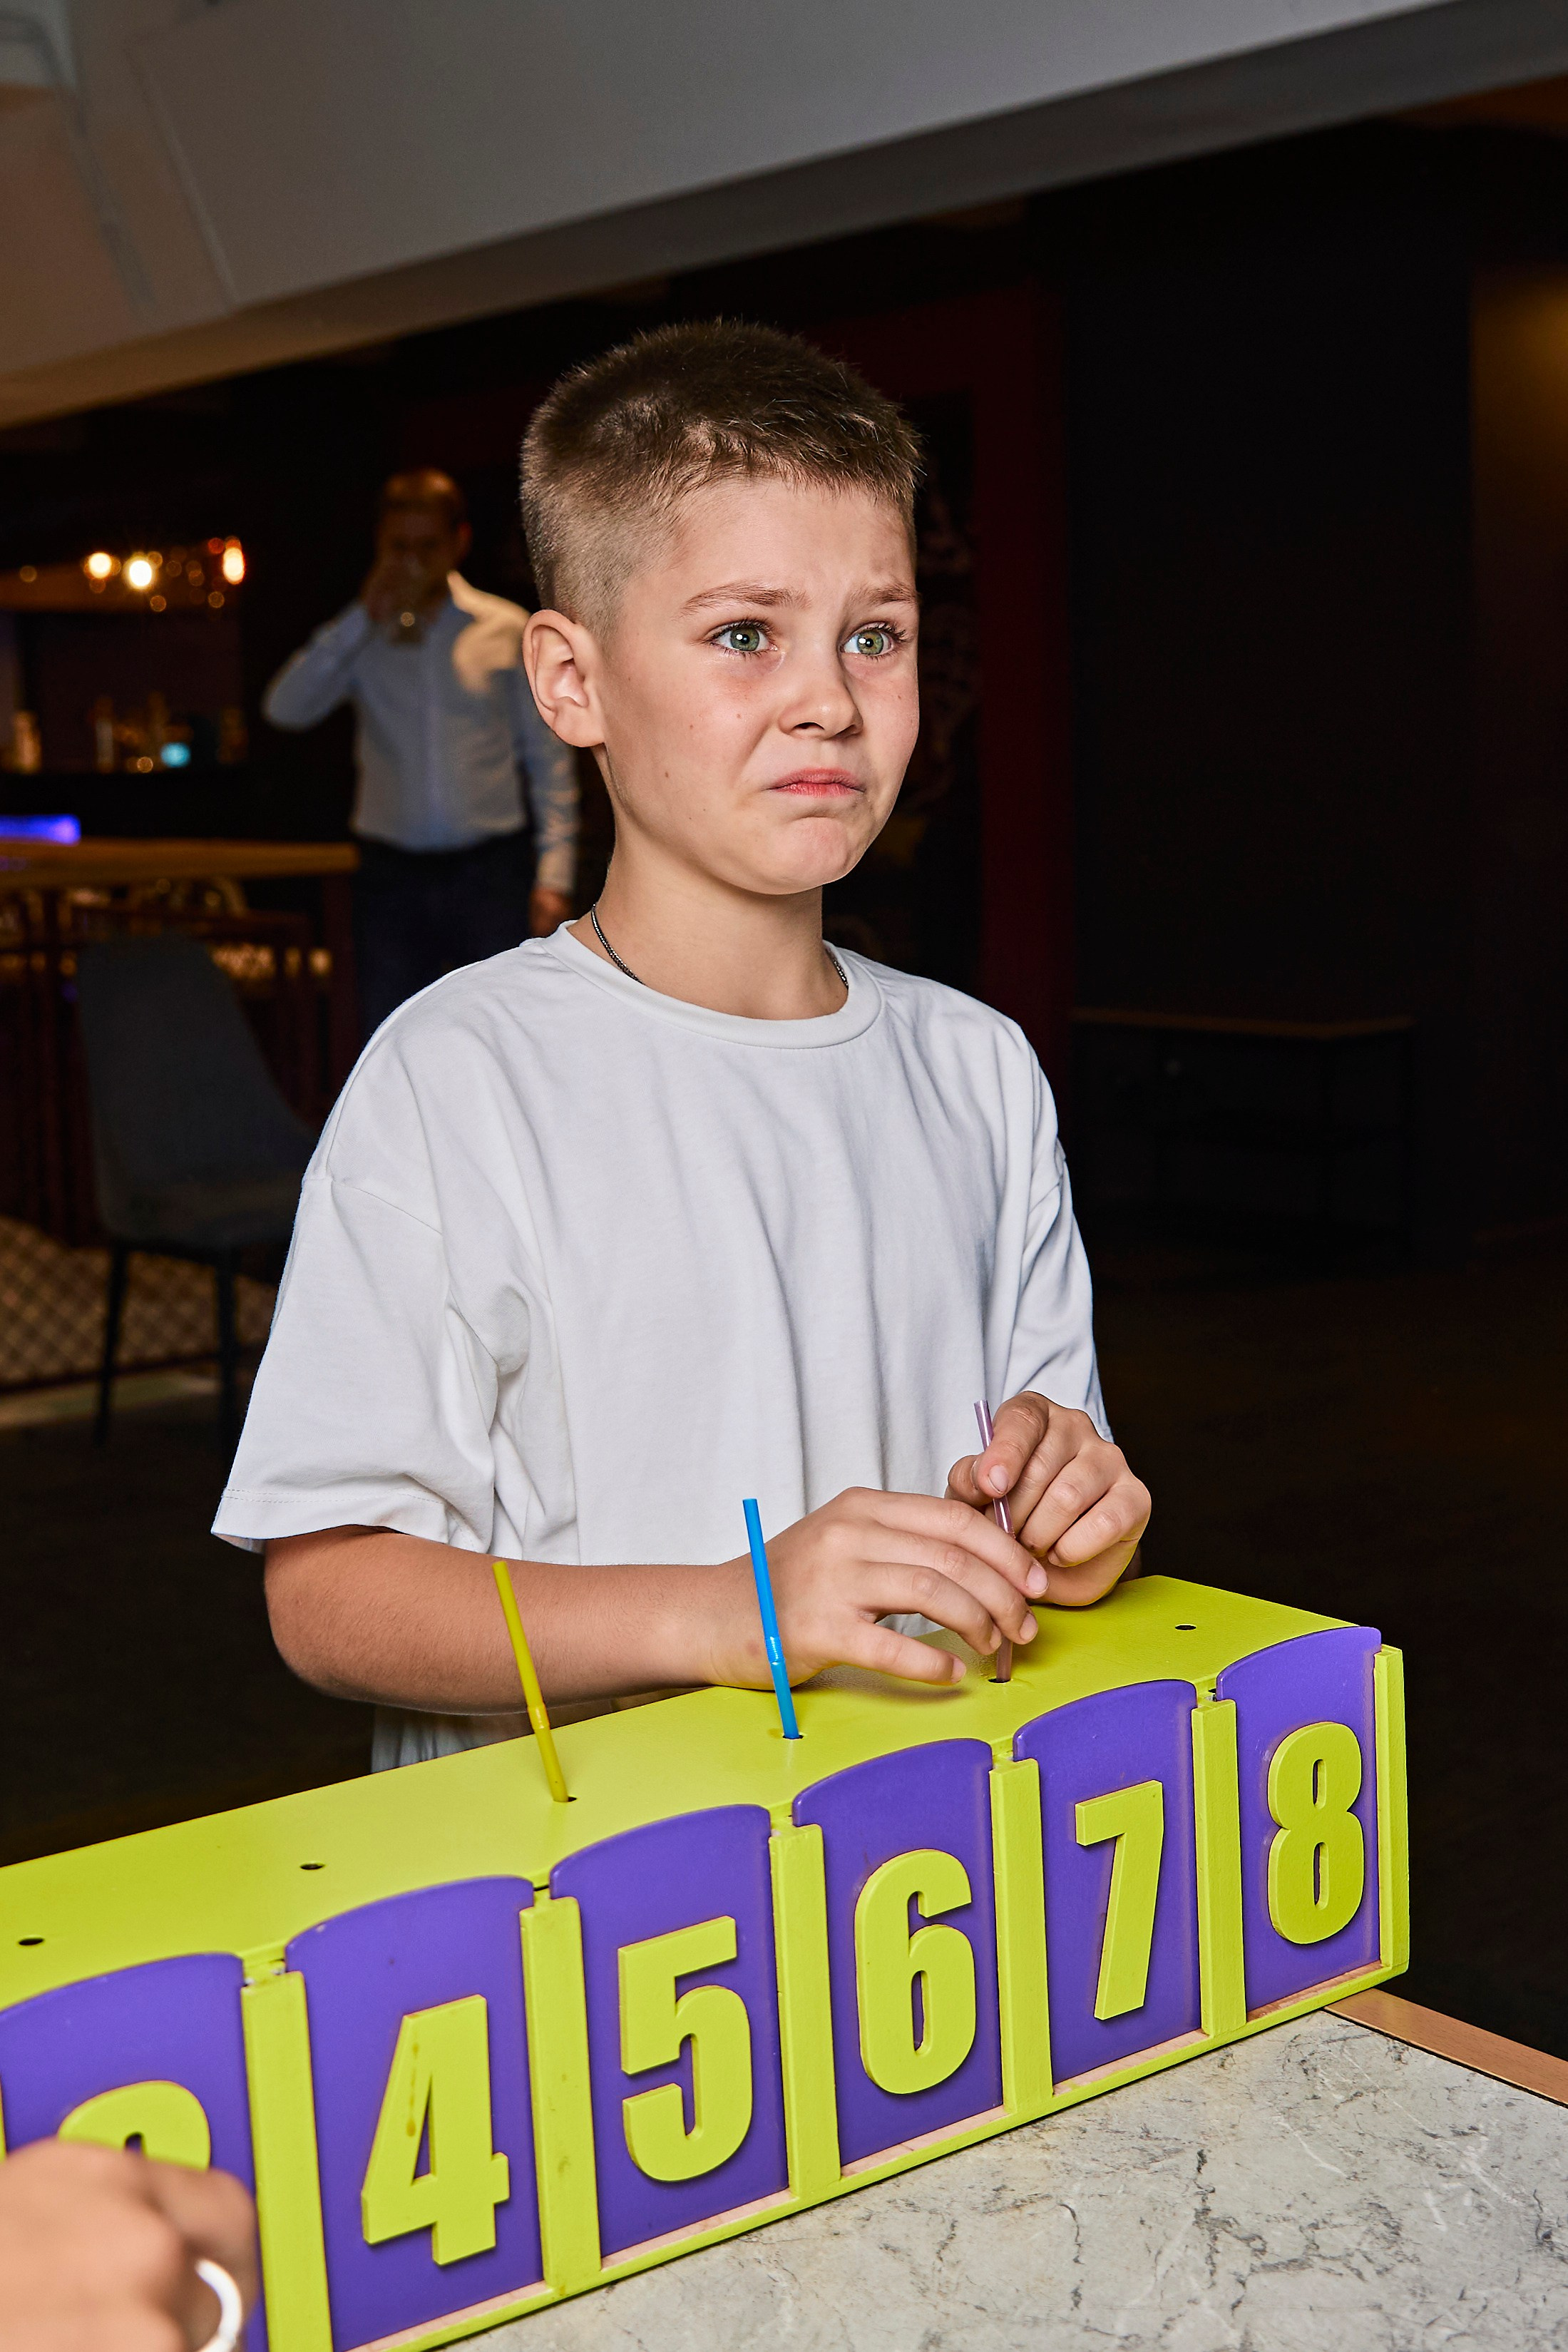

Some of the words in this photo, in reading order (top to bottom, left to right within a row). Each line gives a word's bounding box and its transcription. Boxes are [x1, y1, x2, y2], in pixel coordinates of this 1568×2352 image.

[1075, 1779, 1164, 2020] 7
[1267, 1721, 1365, 1945] 8
[618, 1915, 754, 2183] 5
[854, 1847, 977, 2095] 6
[361, 1994, 510, 2266] 4
